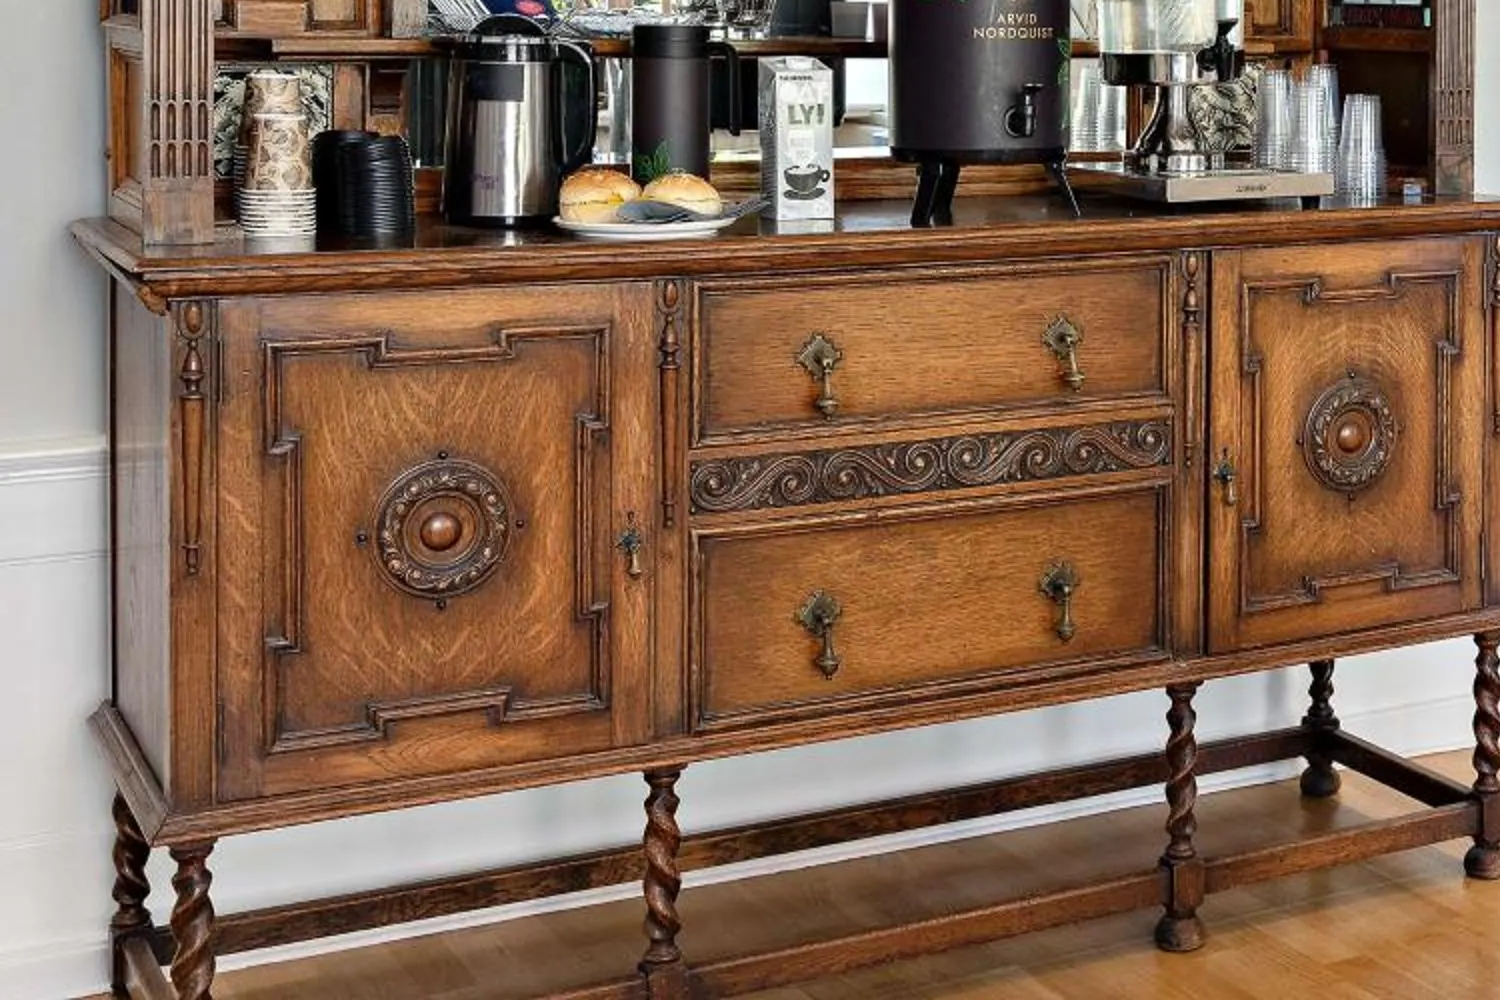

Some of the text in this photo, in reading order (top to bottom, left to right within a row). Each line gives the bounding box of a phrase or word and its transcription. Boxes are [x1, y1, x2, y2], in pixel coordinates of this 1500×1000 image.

[997, 13, 1037, 25] ARVID
[973, 27, 1054, 39] NORDQUIST
[787, 103, 825, 125] LY!
